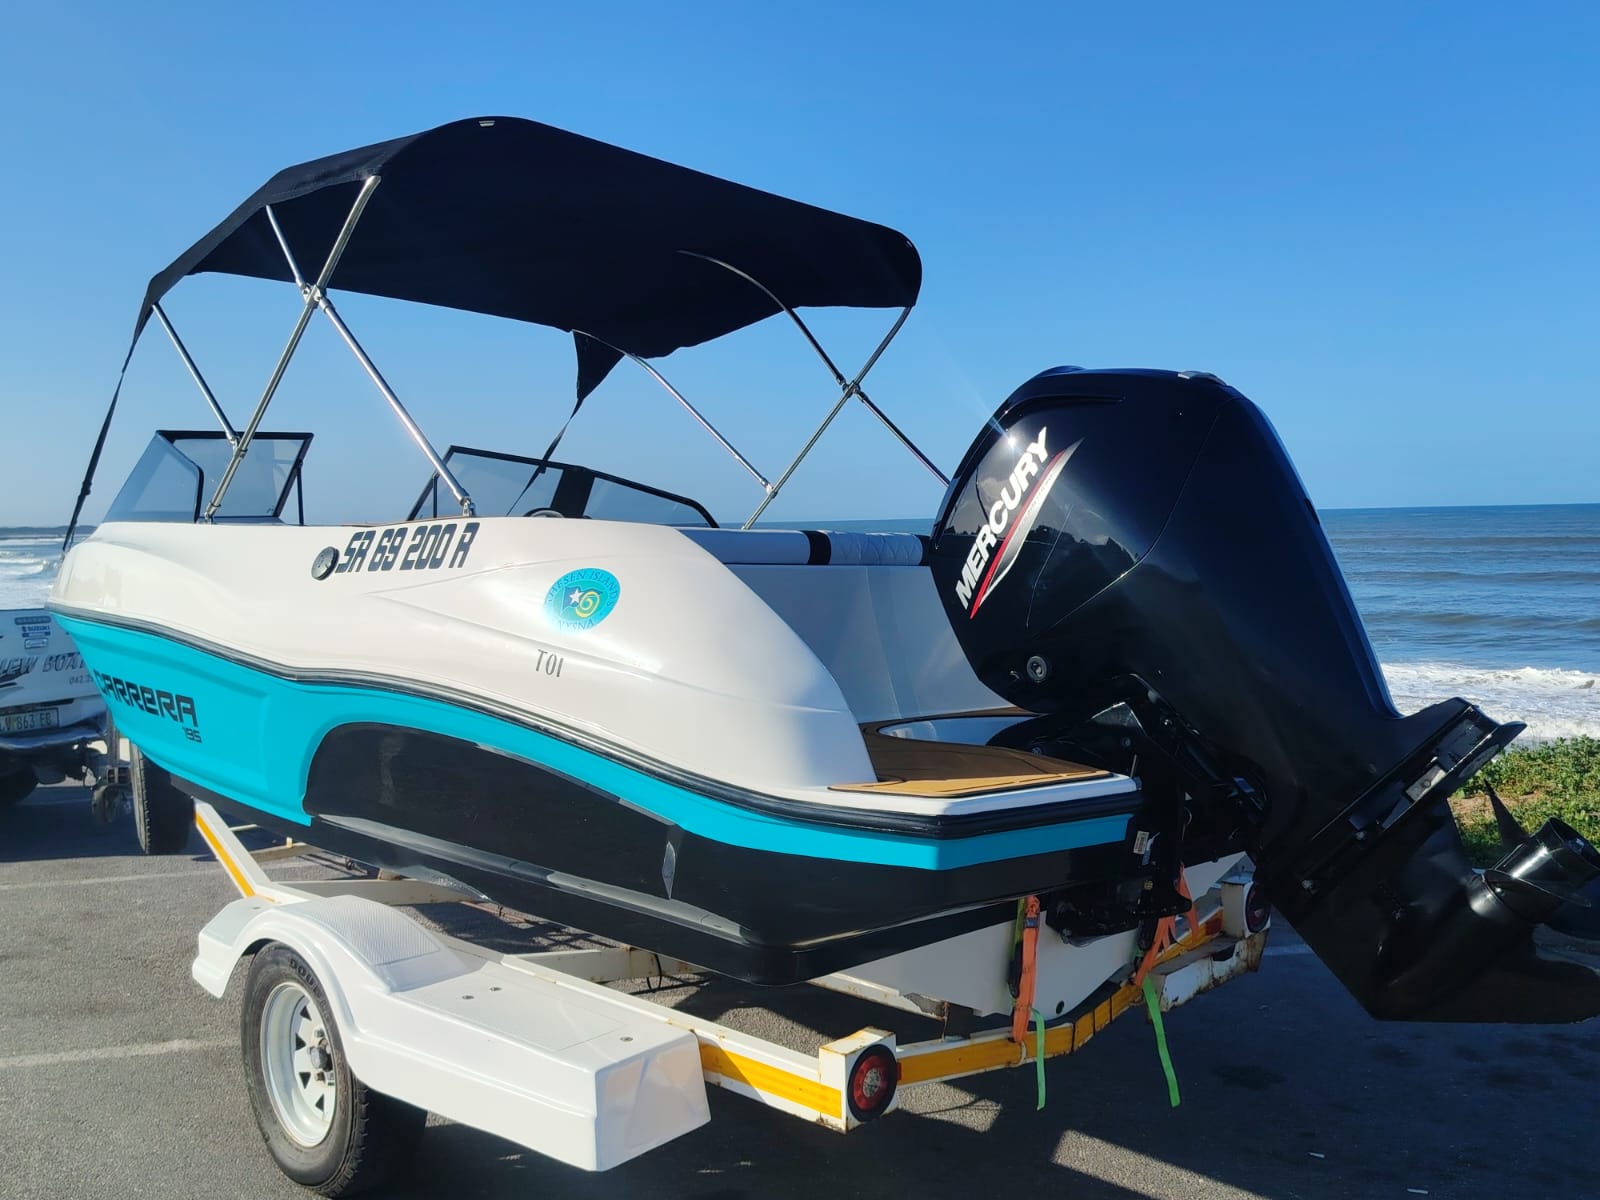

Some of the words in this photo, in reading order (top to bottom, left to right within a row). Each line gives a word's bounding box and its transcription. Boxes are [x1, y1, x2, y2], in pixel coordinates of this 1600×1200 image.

[367, 527, 408, 572] 69
[399, 523, 457, 570] 200
[956, 426, 1049, 610] MERCURY
